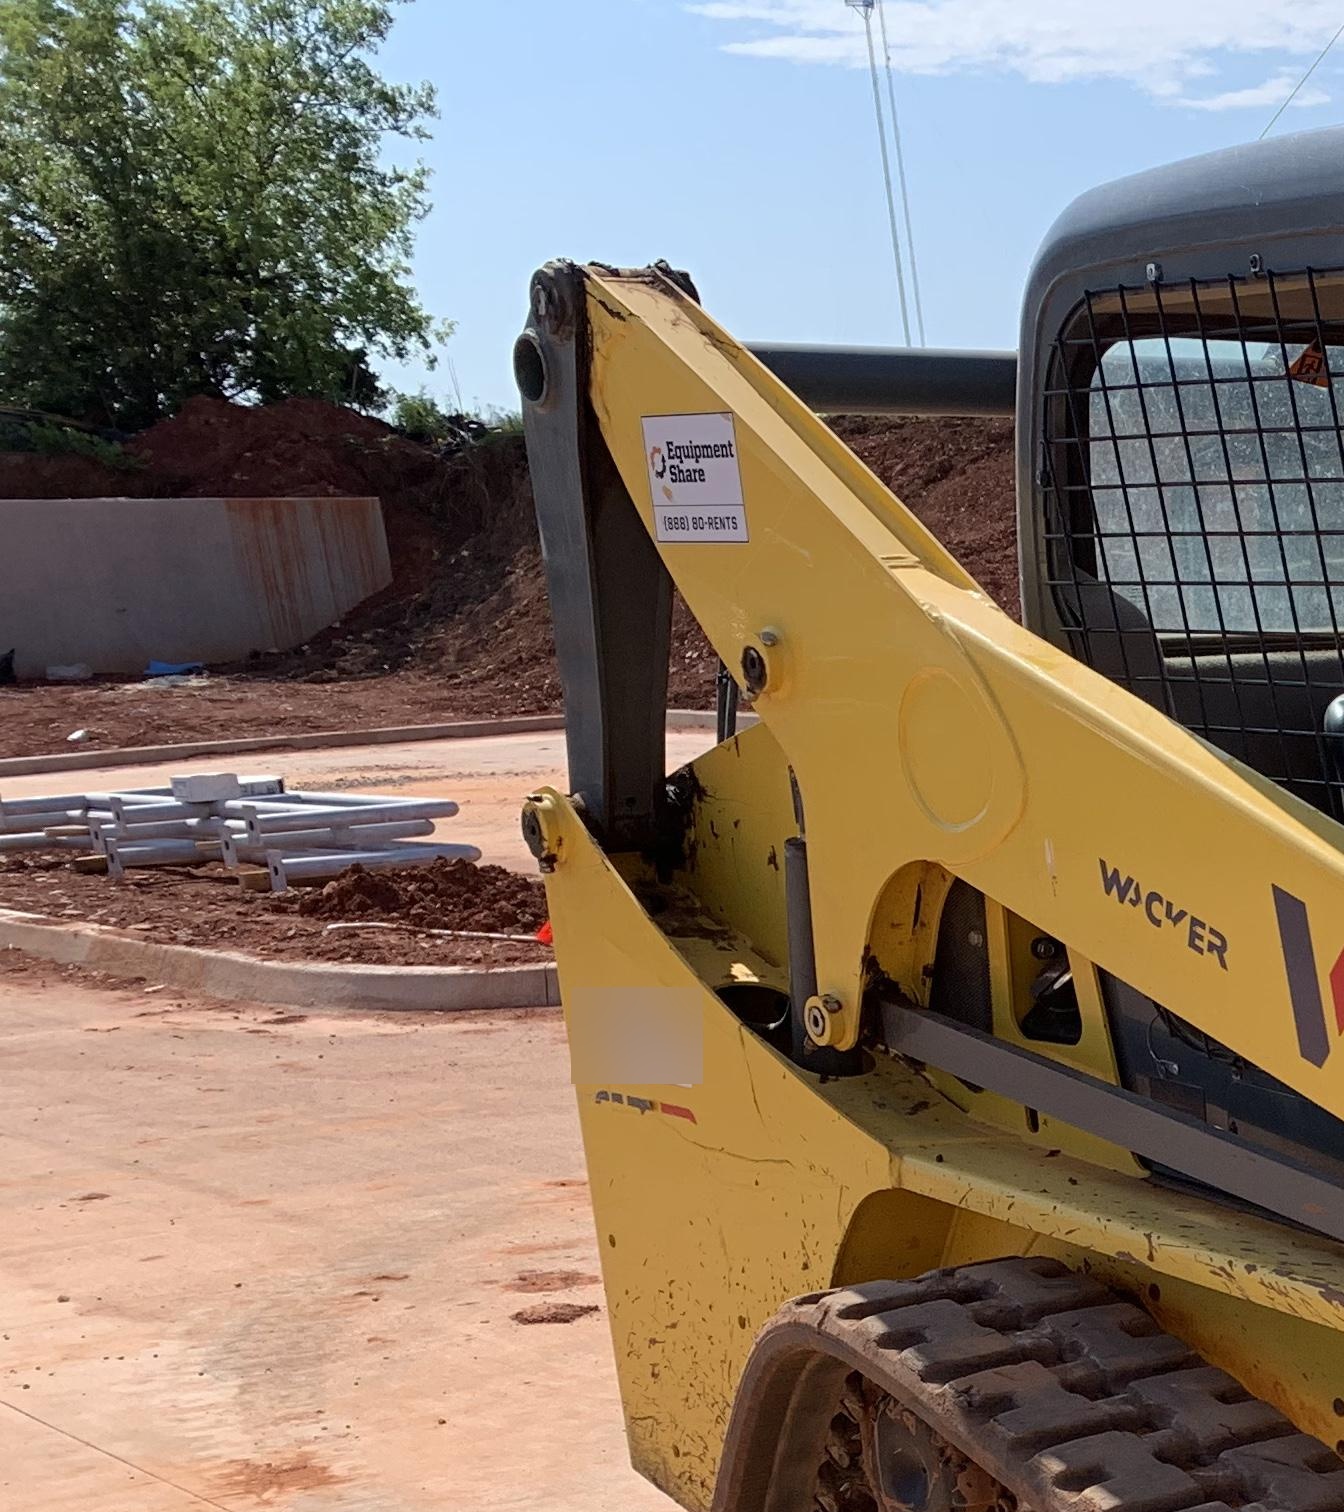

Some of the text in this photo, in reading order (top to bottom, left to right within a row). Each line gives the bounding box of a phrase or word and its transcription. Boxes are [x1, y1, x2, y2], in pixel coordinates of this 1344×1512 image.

[666, 440, 735, 464] Equipment
[669, 464, 706, 484] Share
[663, 515, 738, 532] (888) 80-RENTS
